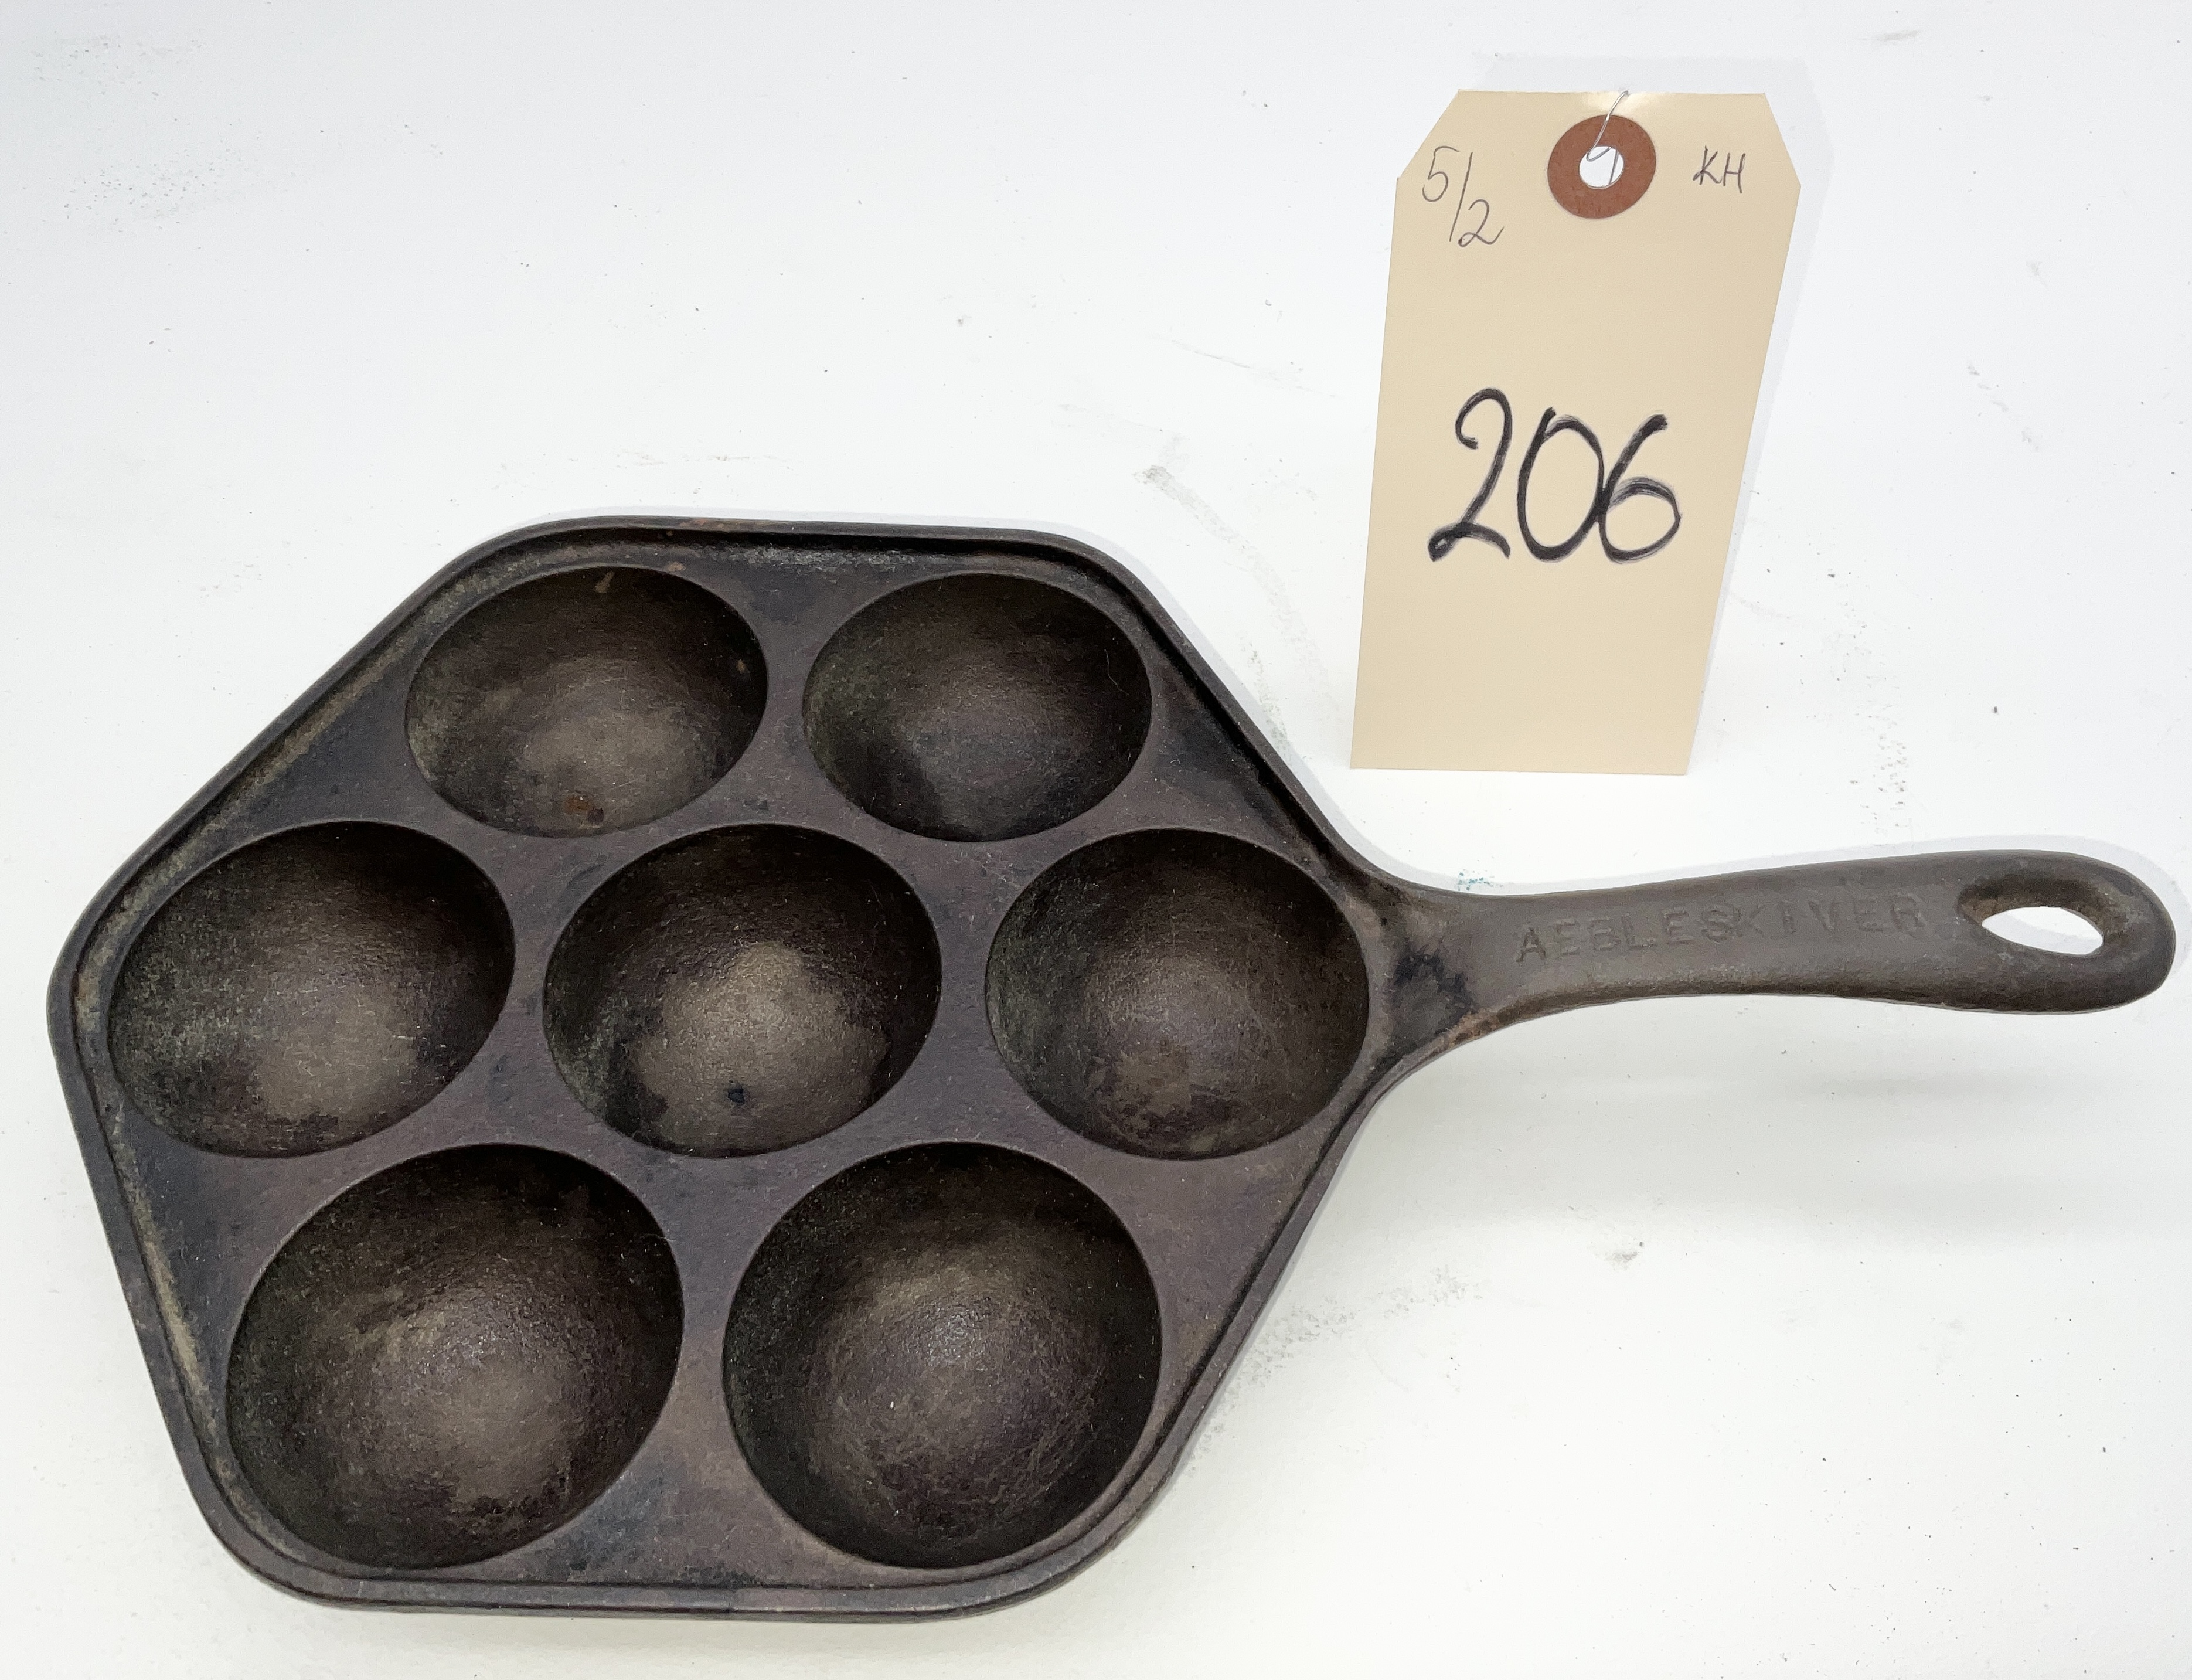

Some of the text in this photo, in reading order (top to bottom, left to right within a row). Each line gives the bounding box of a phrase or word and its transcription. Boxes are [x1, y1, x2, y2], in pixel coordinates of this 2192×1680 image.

[1421, 145, 1505, 247] 5/2
[1692, 145, 1747, 194] KH
[1427, 387, 1681, 563] 206
[1516, 891, 1926, 963] AEBLESKIVER
